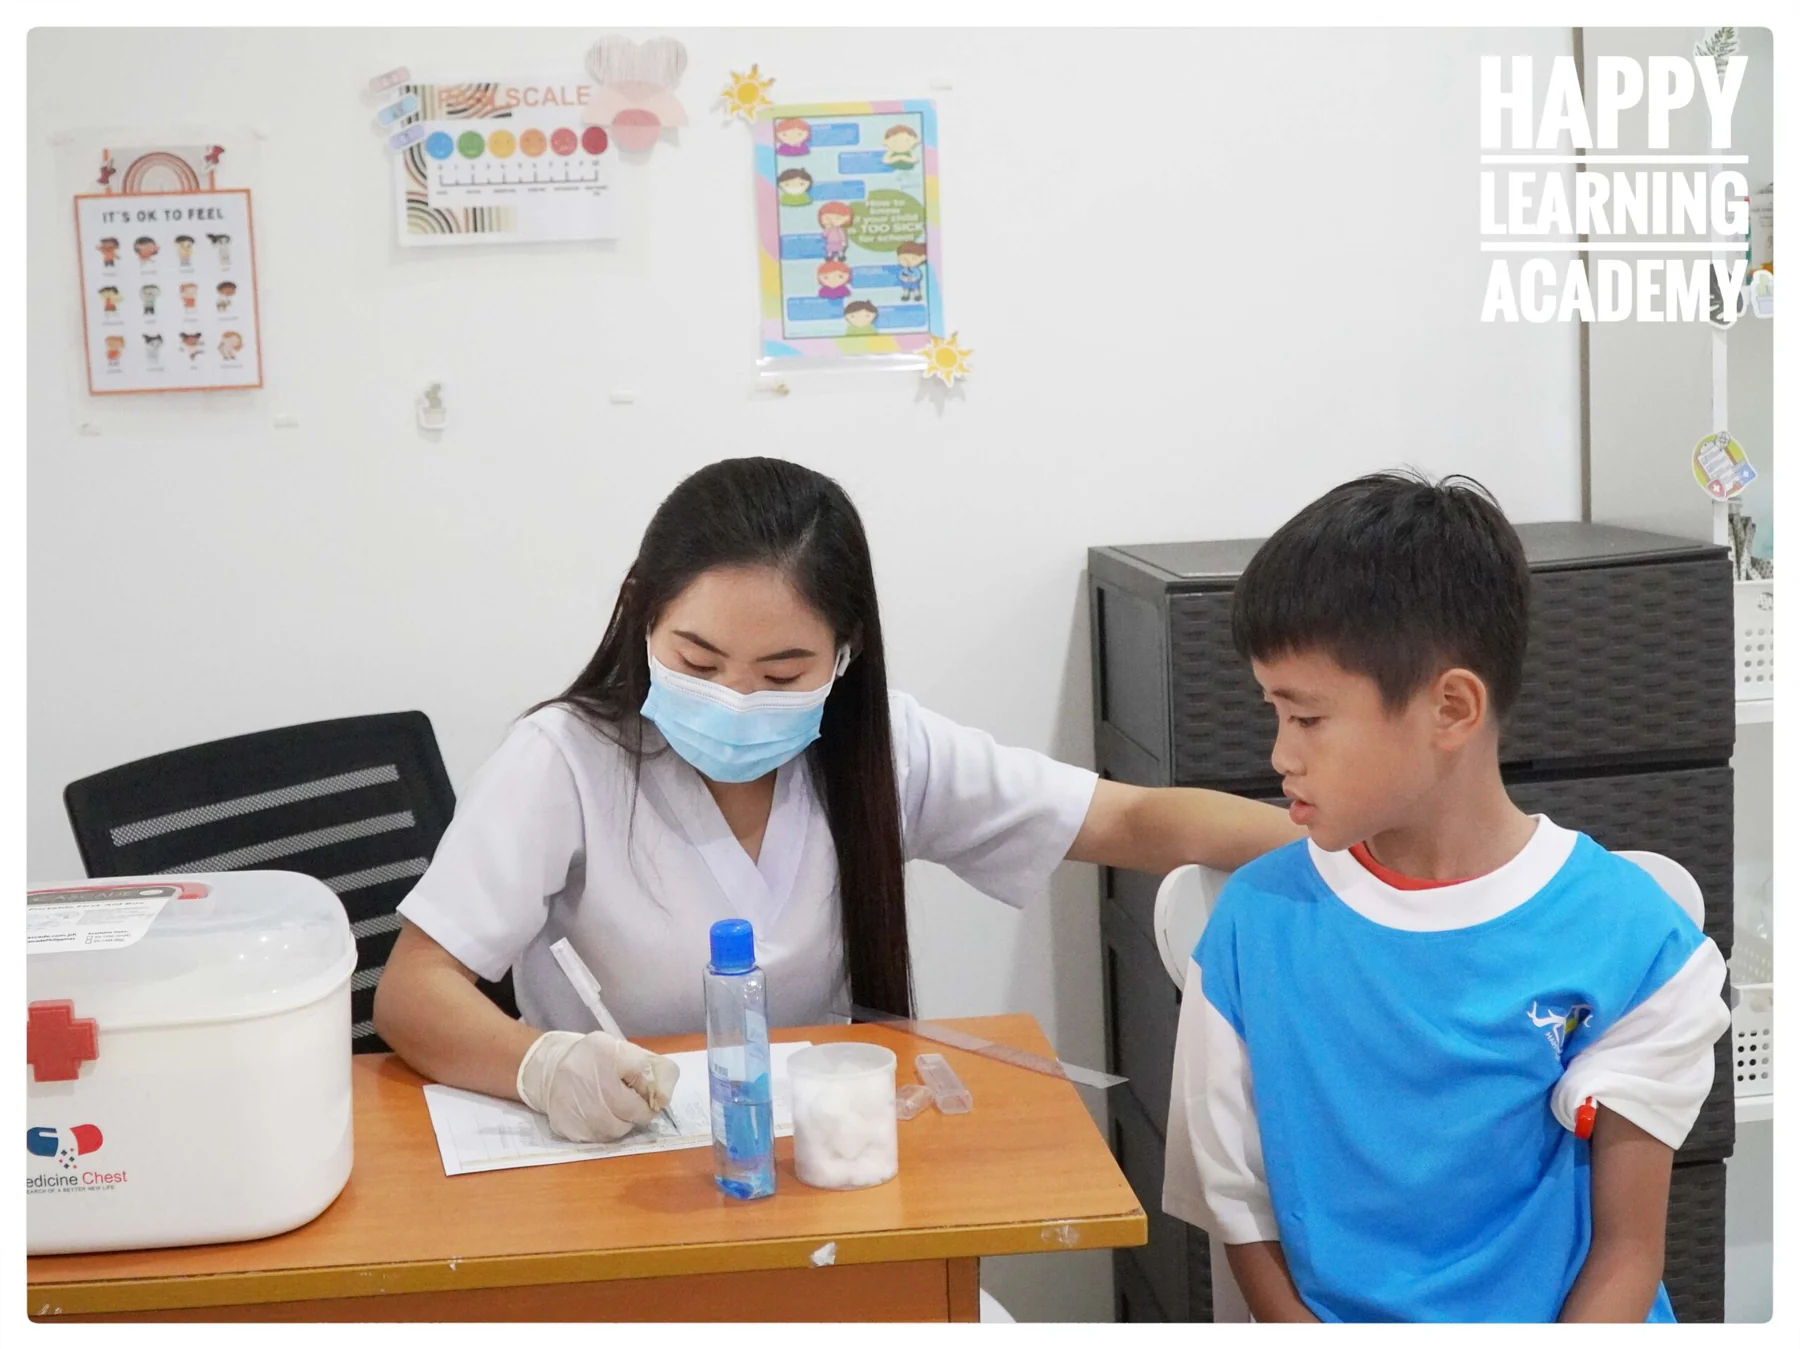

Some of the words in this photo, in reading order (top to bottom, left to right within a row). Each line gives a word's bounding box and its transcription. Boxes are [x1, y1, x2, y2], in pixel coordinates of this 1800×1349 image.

[505, 84, 591, 108] SCALE
[102, 211, 130, 224] IT'S
[136, 210, 157, 222] OK
[164, 209, 182, 221] TO
[187, 208, 224, 221] FEEL
[860, 224, 892, 235] TOO
[893, 222, 925, 233] SICK
[27, 1174, 78, 1188] edicine
[82, 1170, 128, 1185] Chest
